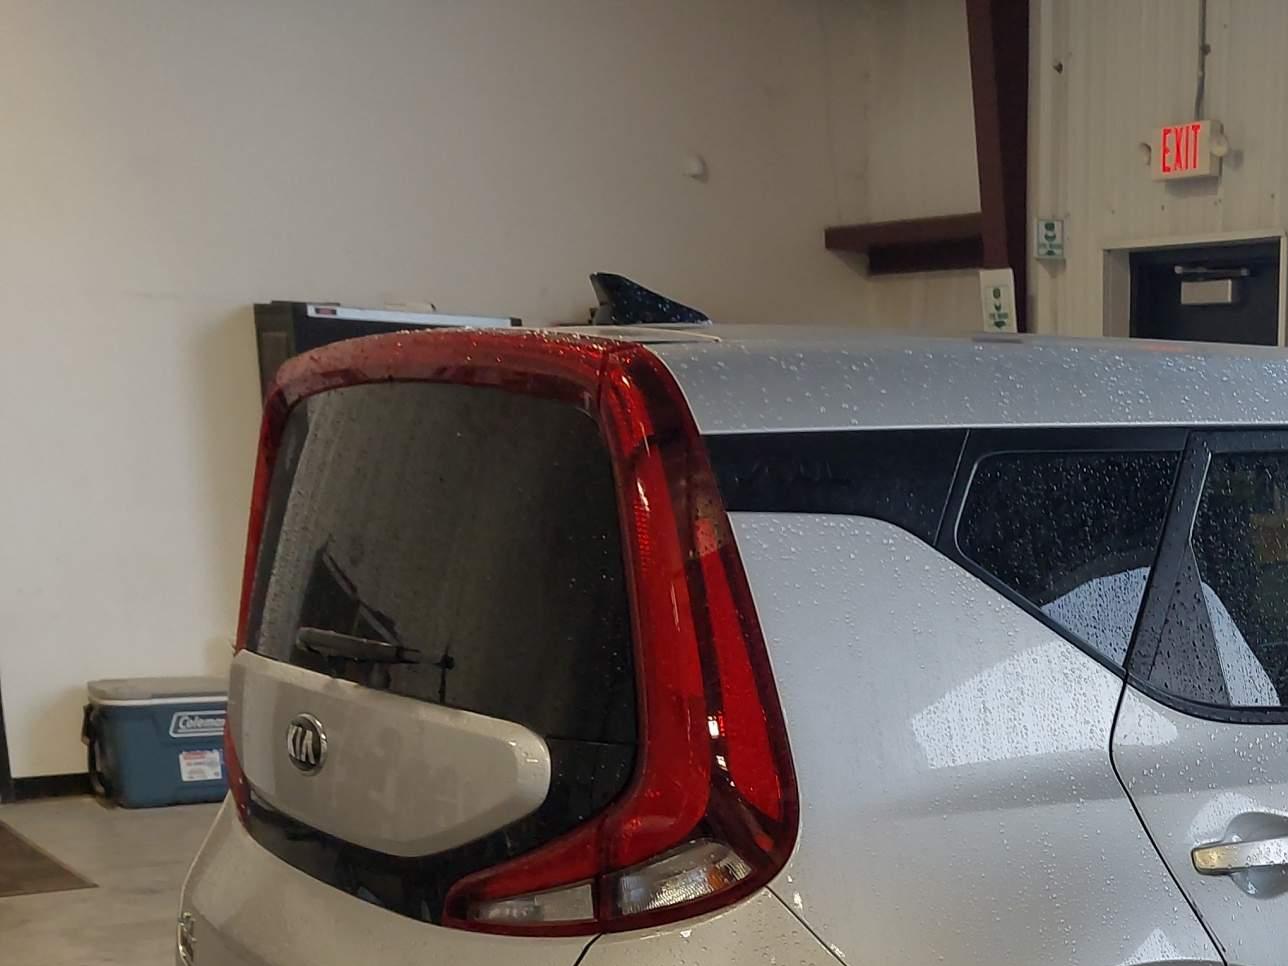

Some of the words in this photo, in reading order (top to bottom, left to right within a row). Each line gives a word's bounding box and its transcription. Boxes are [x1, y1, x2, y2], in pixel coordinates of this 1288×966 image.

[1161, 123, 1201, 173] EXIT
[178, 715, 225, 729] Colema
[287, 723, 316, 765] KIA
